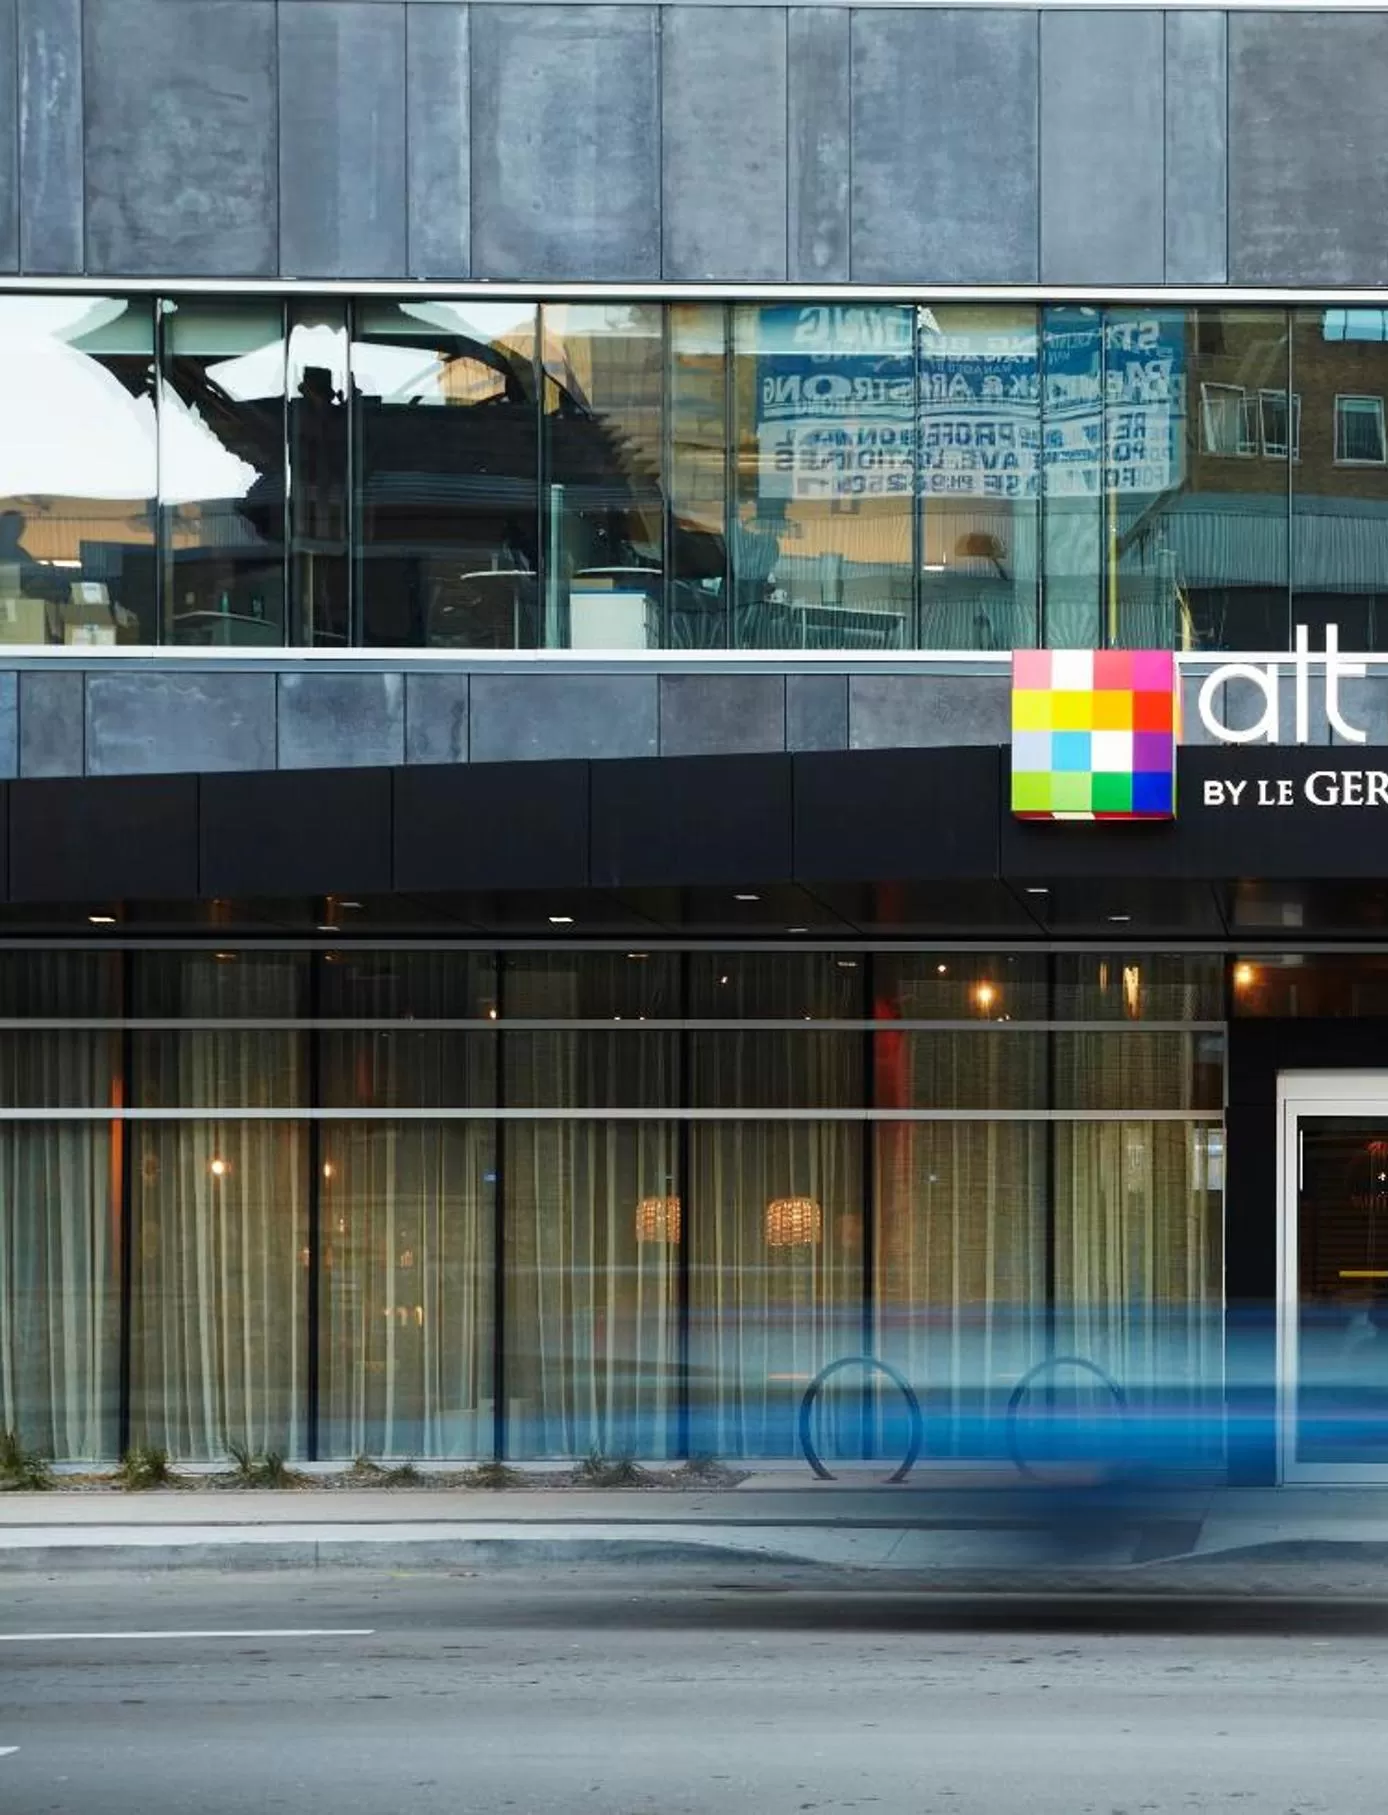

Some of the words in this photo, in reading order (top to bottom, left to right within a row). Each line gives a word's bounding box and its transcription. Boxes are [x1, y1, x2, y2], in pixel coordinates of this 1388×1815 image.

[1199, 623, 1367, 743] alt
[1204, 780, 1247, 806] BY
[1258, 780, 1294, 806] LE
